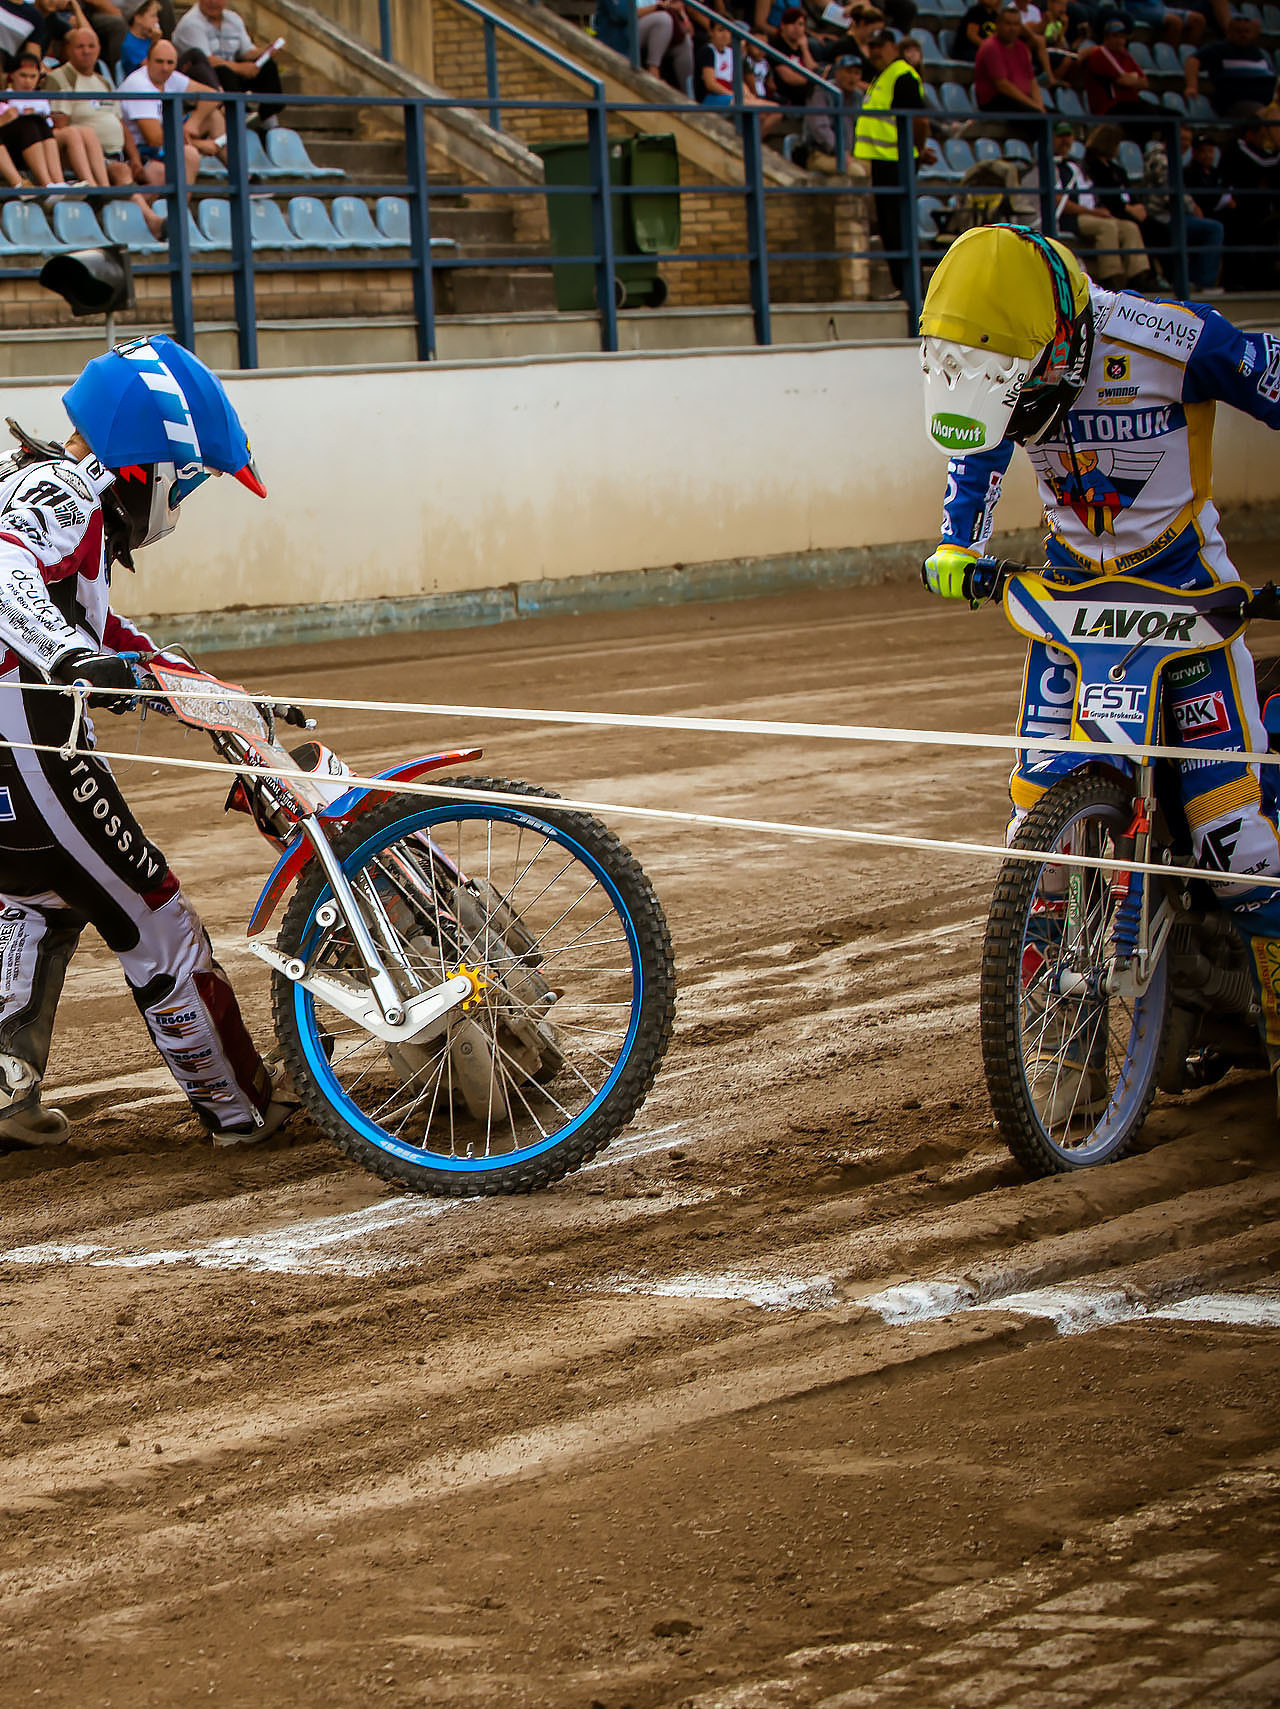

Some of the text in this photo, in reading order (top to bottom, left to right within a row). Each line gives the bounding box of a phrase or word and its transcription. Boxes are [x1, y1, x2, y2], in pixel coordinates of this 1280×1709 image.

[1117, 305, 1198, 343] NICOLAUS
[1153, 331, 1194, 351] BANK
[1002, 372, 1027, 409] Nice
[931, 416, 983, 442] Marwit
[1078, 405, 1172, 441] TORUŃ
[1071, 607, 1198, 642] LAVOR
[1083, 685, 1146, 711] FST
[1090, 711, 1144, 721] Grupa Brokerska
[155, 1010, 198, 1025] ERGOSS
